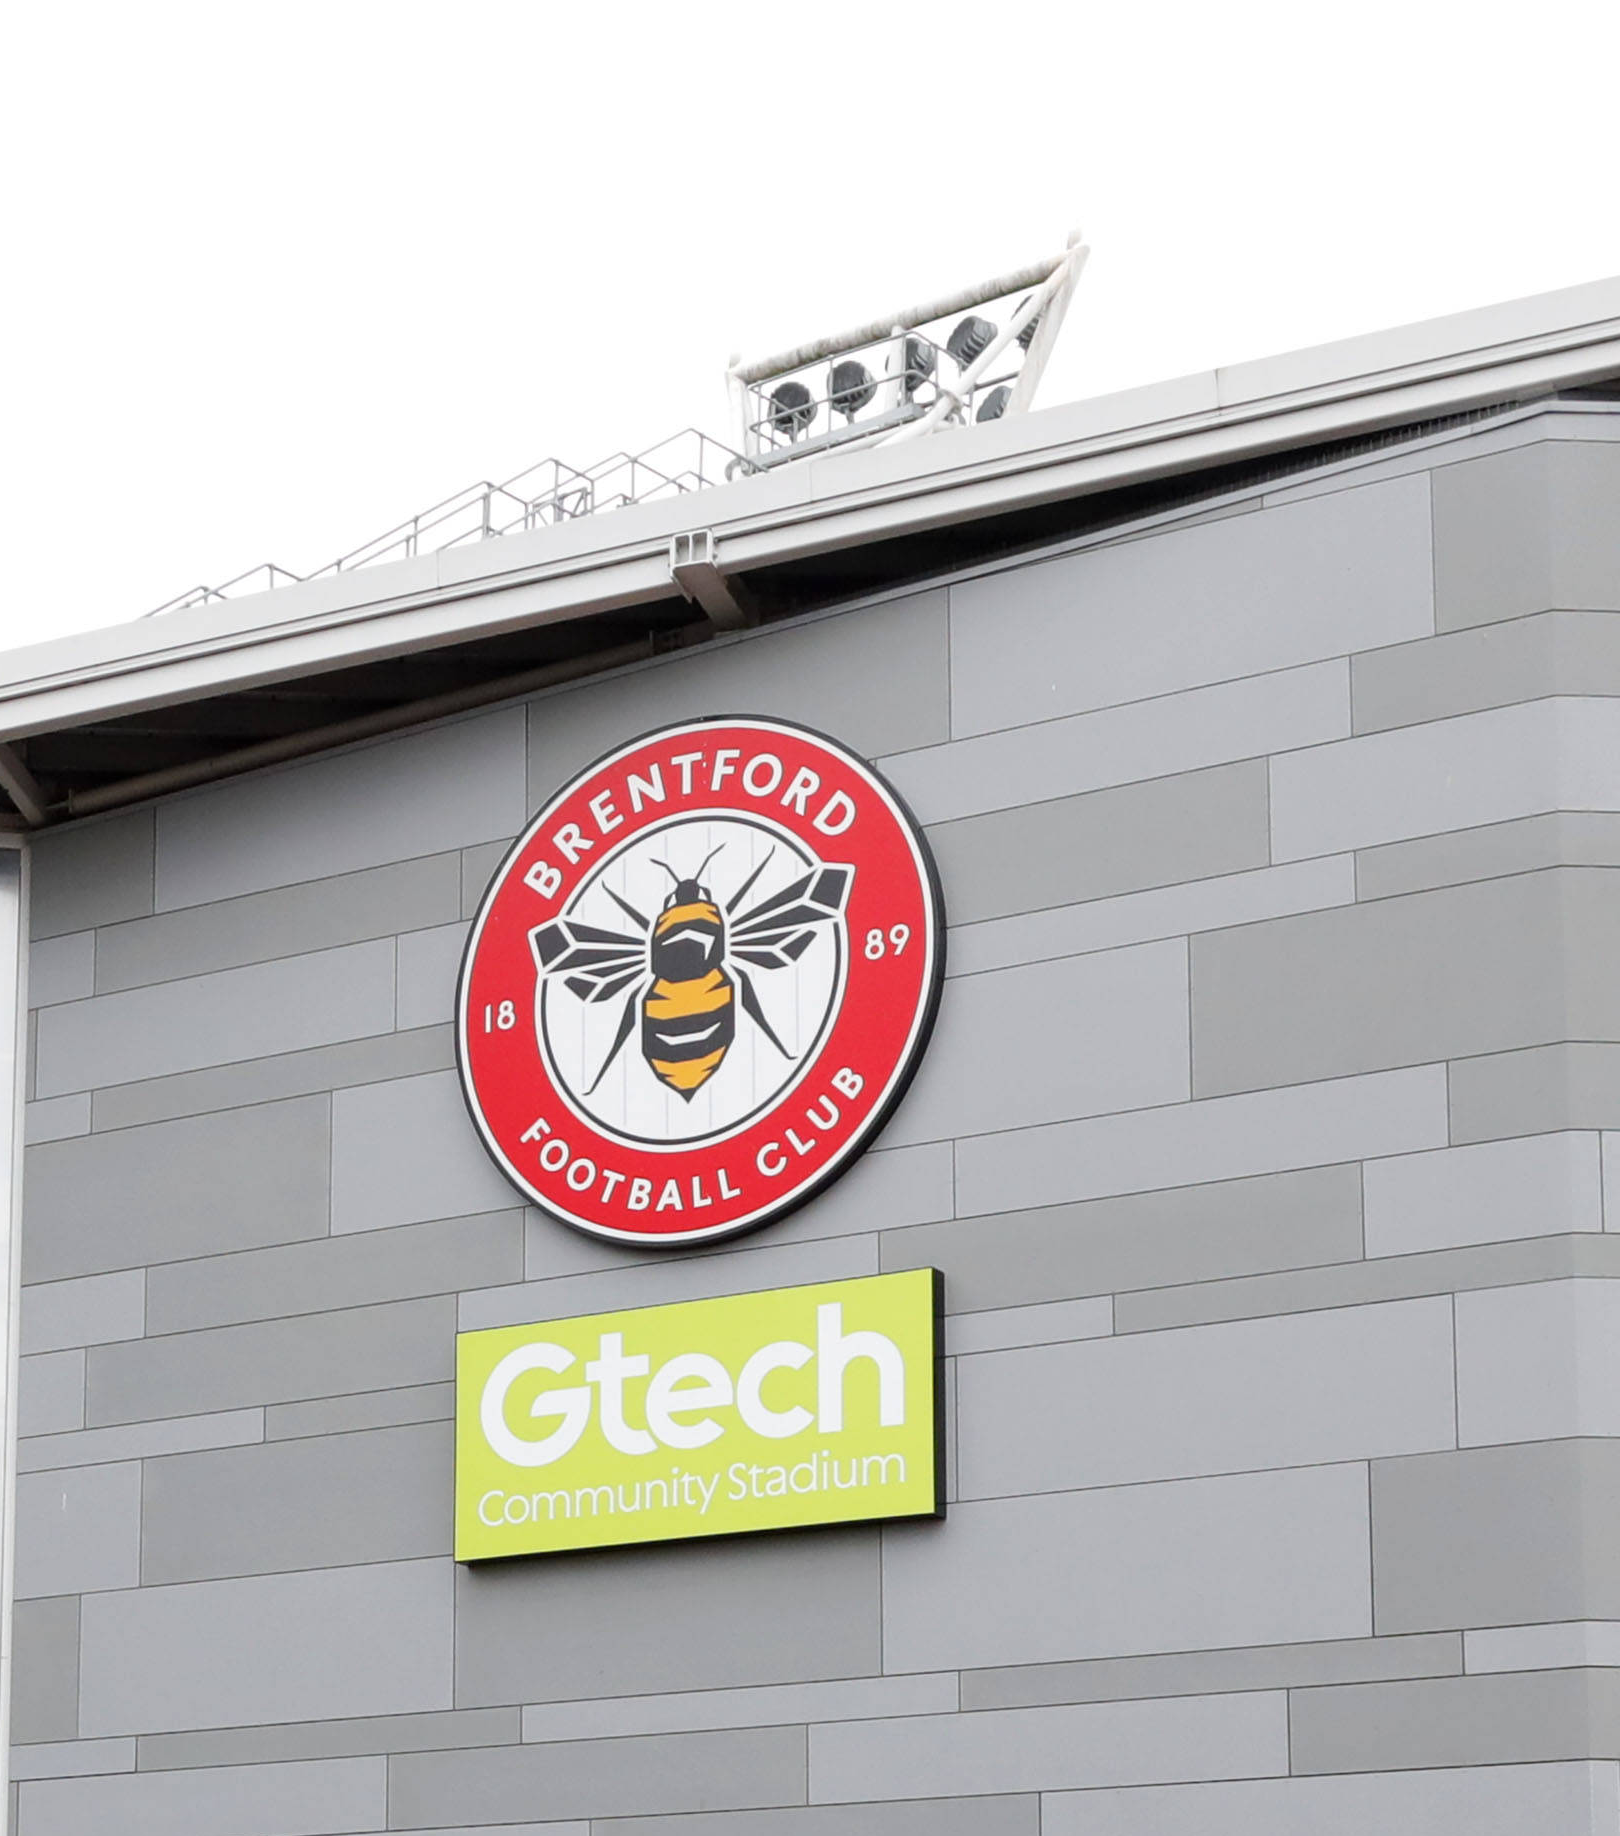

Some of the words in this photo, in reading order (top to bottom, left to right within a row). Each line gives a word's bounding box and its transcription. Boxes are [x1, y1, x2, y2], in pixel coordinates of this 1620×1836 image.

[523, 748, 857, 900] BRENTFORD
[864, 924, 910, 960] 89
[483, 1000, 517, 1033] 18
[519, 1116, 741, 1213] FOOTBALL
[756, 1065, 865, 1178] CLUB
[479, 1301, 906, 1468] Gtech
[477, 1466, 720, 1527] Community
[727, 1449, 907, 1500] Stadium
